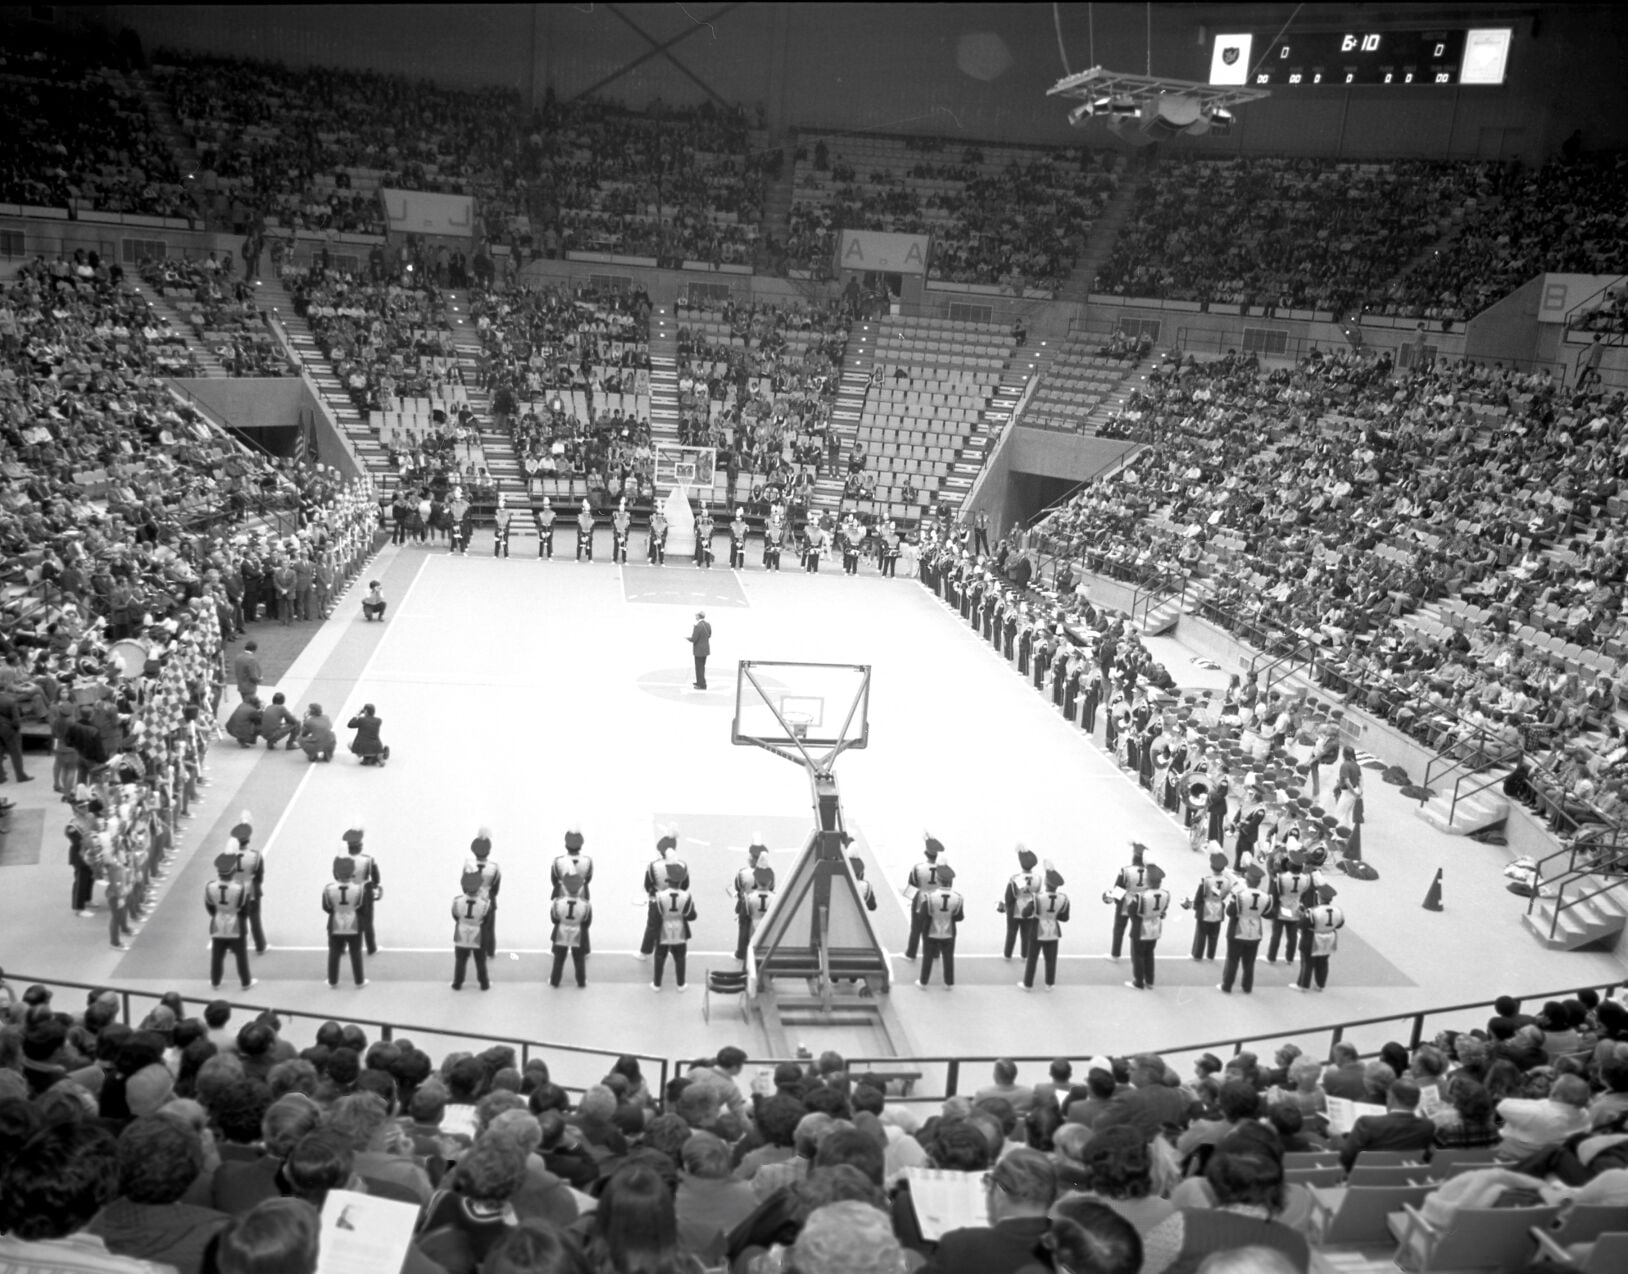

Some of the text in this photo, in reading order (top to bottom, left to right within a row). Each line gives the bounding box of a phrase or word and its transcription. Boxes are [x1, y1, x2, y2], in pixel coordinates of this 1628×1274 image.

[1341, 34, 1381, 51] 6:10
[1434, 43, 1445, 57] 0
[1280, 46, 1290, 59] 0
[448, 204, 470, 227] J
[845, 238, 923, 266] A A
[1543, 284, 1568, 311] B
[928, 867, 937, 885] I
[1136, 868, 1145, 888] I
[1291, 876, 1300, 893] I
[218, 885, 228, 906] I
[339, 886, 349, 905] I
[669, 893, 679, 912] I
[758, 894, 768, 912] I
[939, 894, 950, 913] I
[1047, 895, 1057, 913] I
[1152, 893, 1161, 912] I
[1249, 893, 1260, 911] I
[465, 900, 476, 919] I
[566, 900, 577, 920] I
[1325, 908, 1333, 927] I
